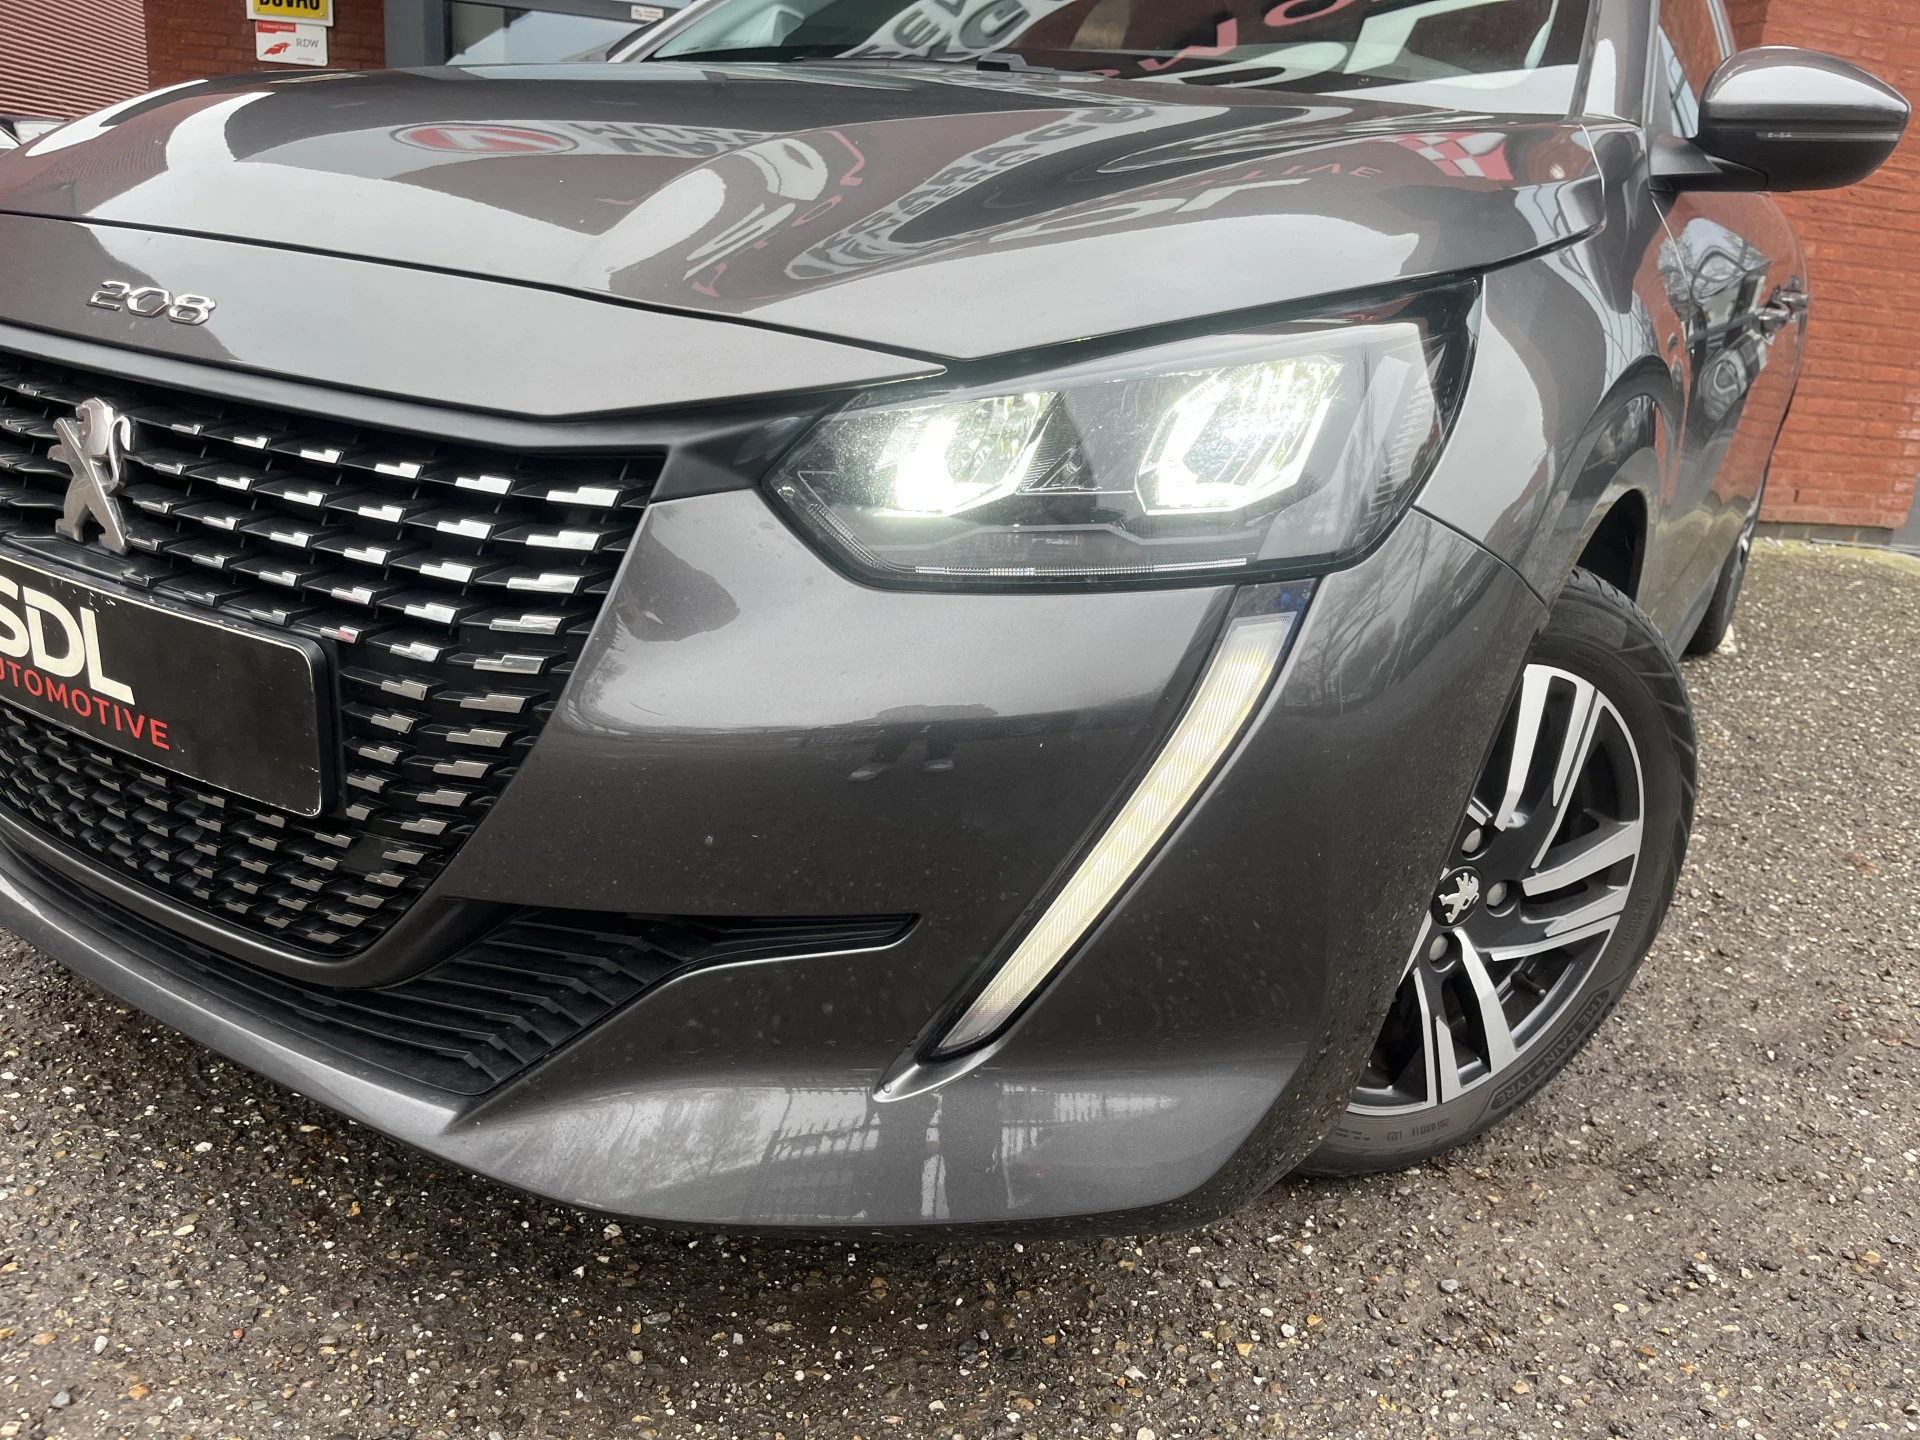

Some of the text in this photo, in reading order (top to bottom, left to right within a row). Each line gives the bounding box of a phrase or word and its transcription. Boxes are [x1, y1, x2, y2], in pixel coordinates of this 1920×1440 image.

[295, 38, 319, 48] RDW
[86, 280, 217, 325] 208
[1542, 1027, 1580, 1066] RAIN
[1496, 1074, 1536, 1106] TYRE
